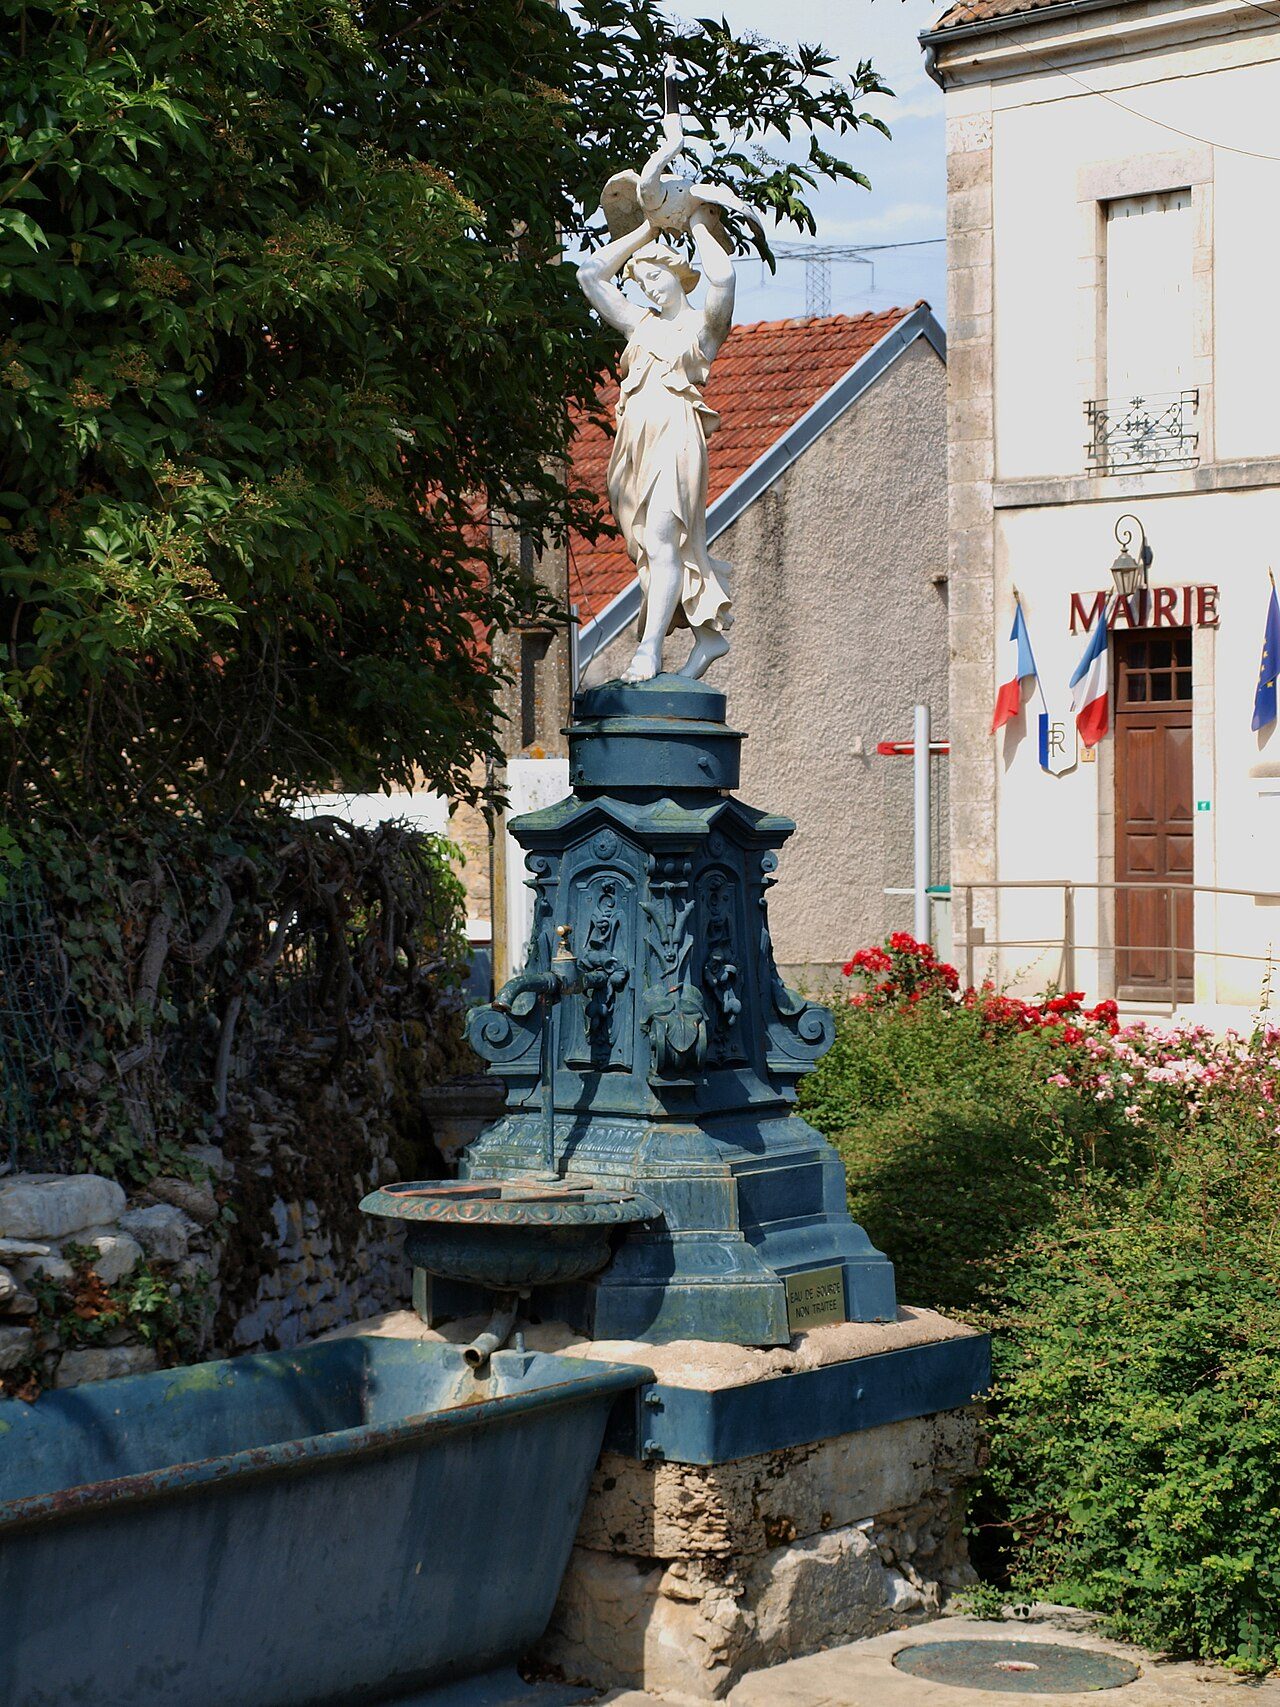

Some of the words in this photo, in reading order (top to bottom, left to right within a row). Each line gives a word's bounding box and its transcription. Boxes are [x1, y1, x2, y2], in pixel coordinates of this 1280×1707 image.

[1069, 586, 1220, 632] MAIRIE
[790, 1291, 803, 1304] EAU
[805, 1288, 813, 1300] DE
[816, 1282, 841, 1298] SOURCE
[795, 1305, 810, 1318] NON
